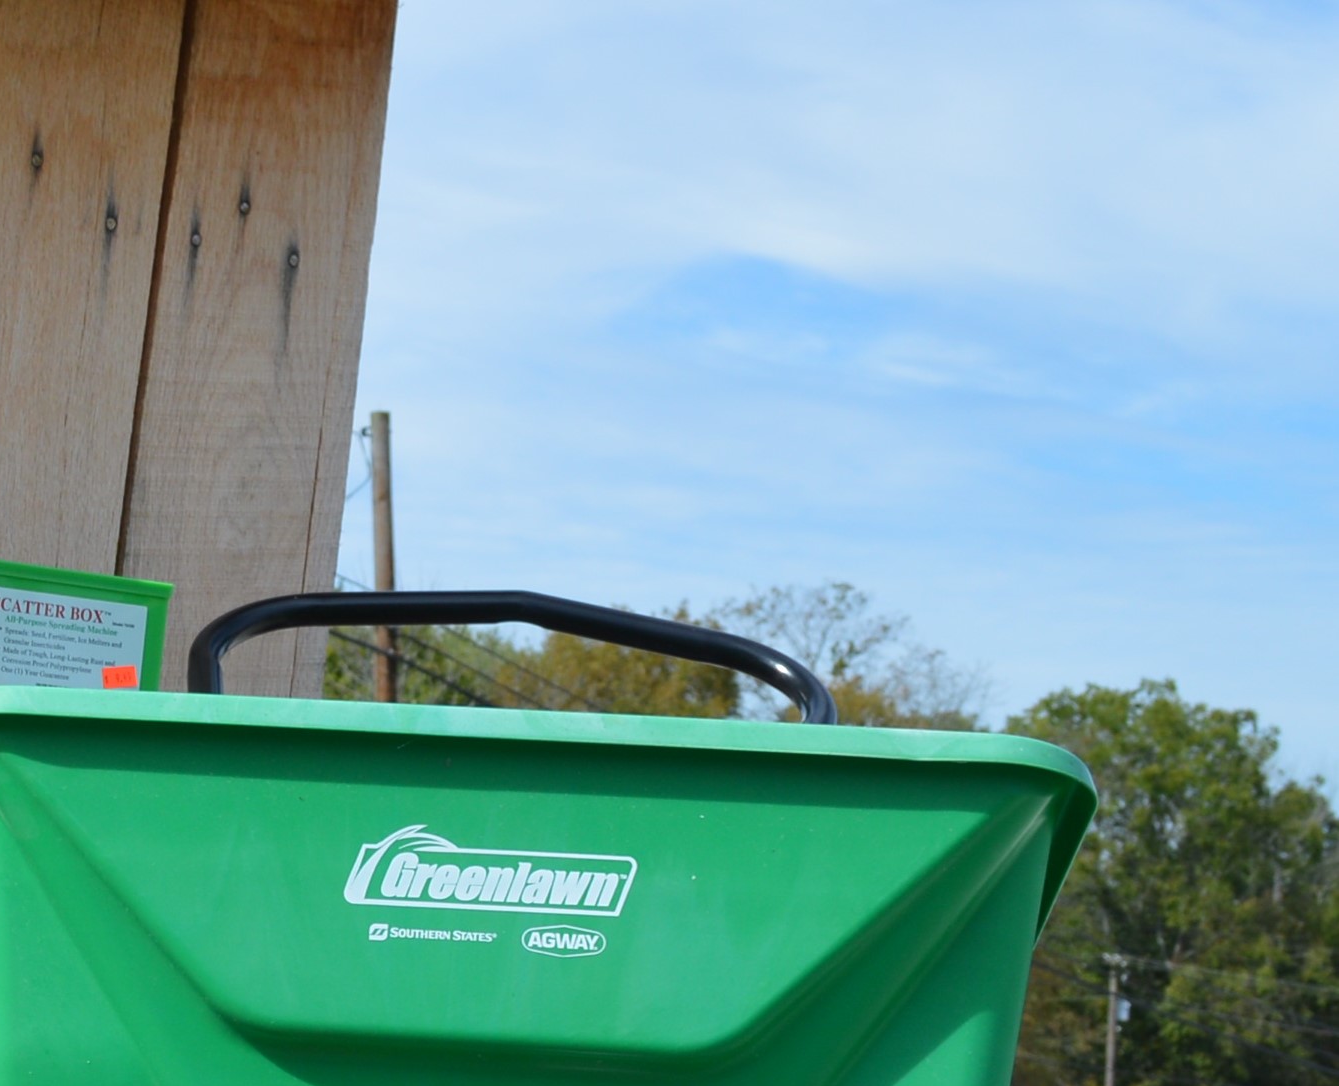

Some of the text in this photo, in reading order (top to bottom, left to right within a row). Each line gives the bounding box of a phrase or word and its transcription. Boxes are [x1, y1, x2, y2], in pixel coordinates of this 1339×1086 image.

[48, 620, 86, 634] Spreading
[87, 624, 118, 637] Machine
[21, 648, 28, 656] of
[111, 641, 122, 649] and
[380, 851, 621, 908] Greenlawn
[390, 926, 451, 941] SOUTHERN
[527, 931, 599, 951] AGWAY
